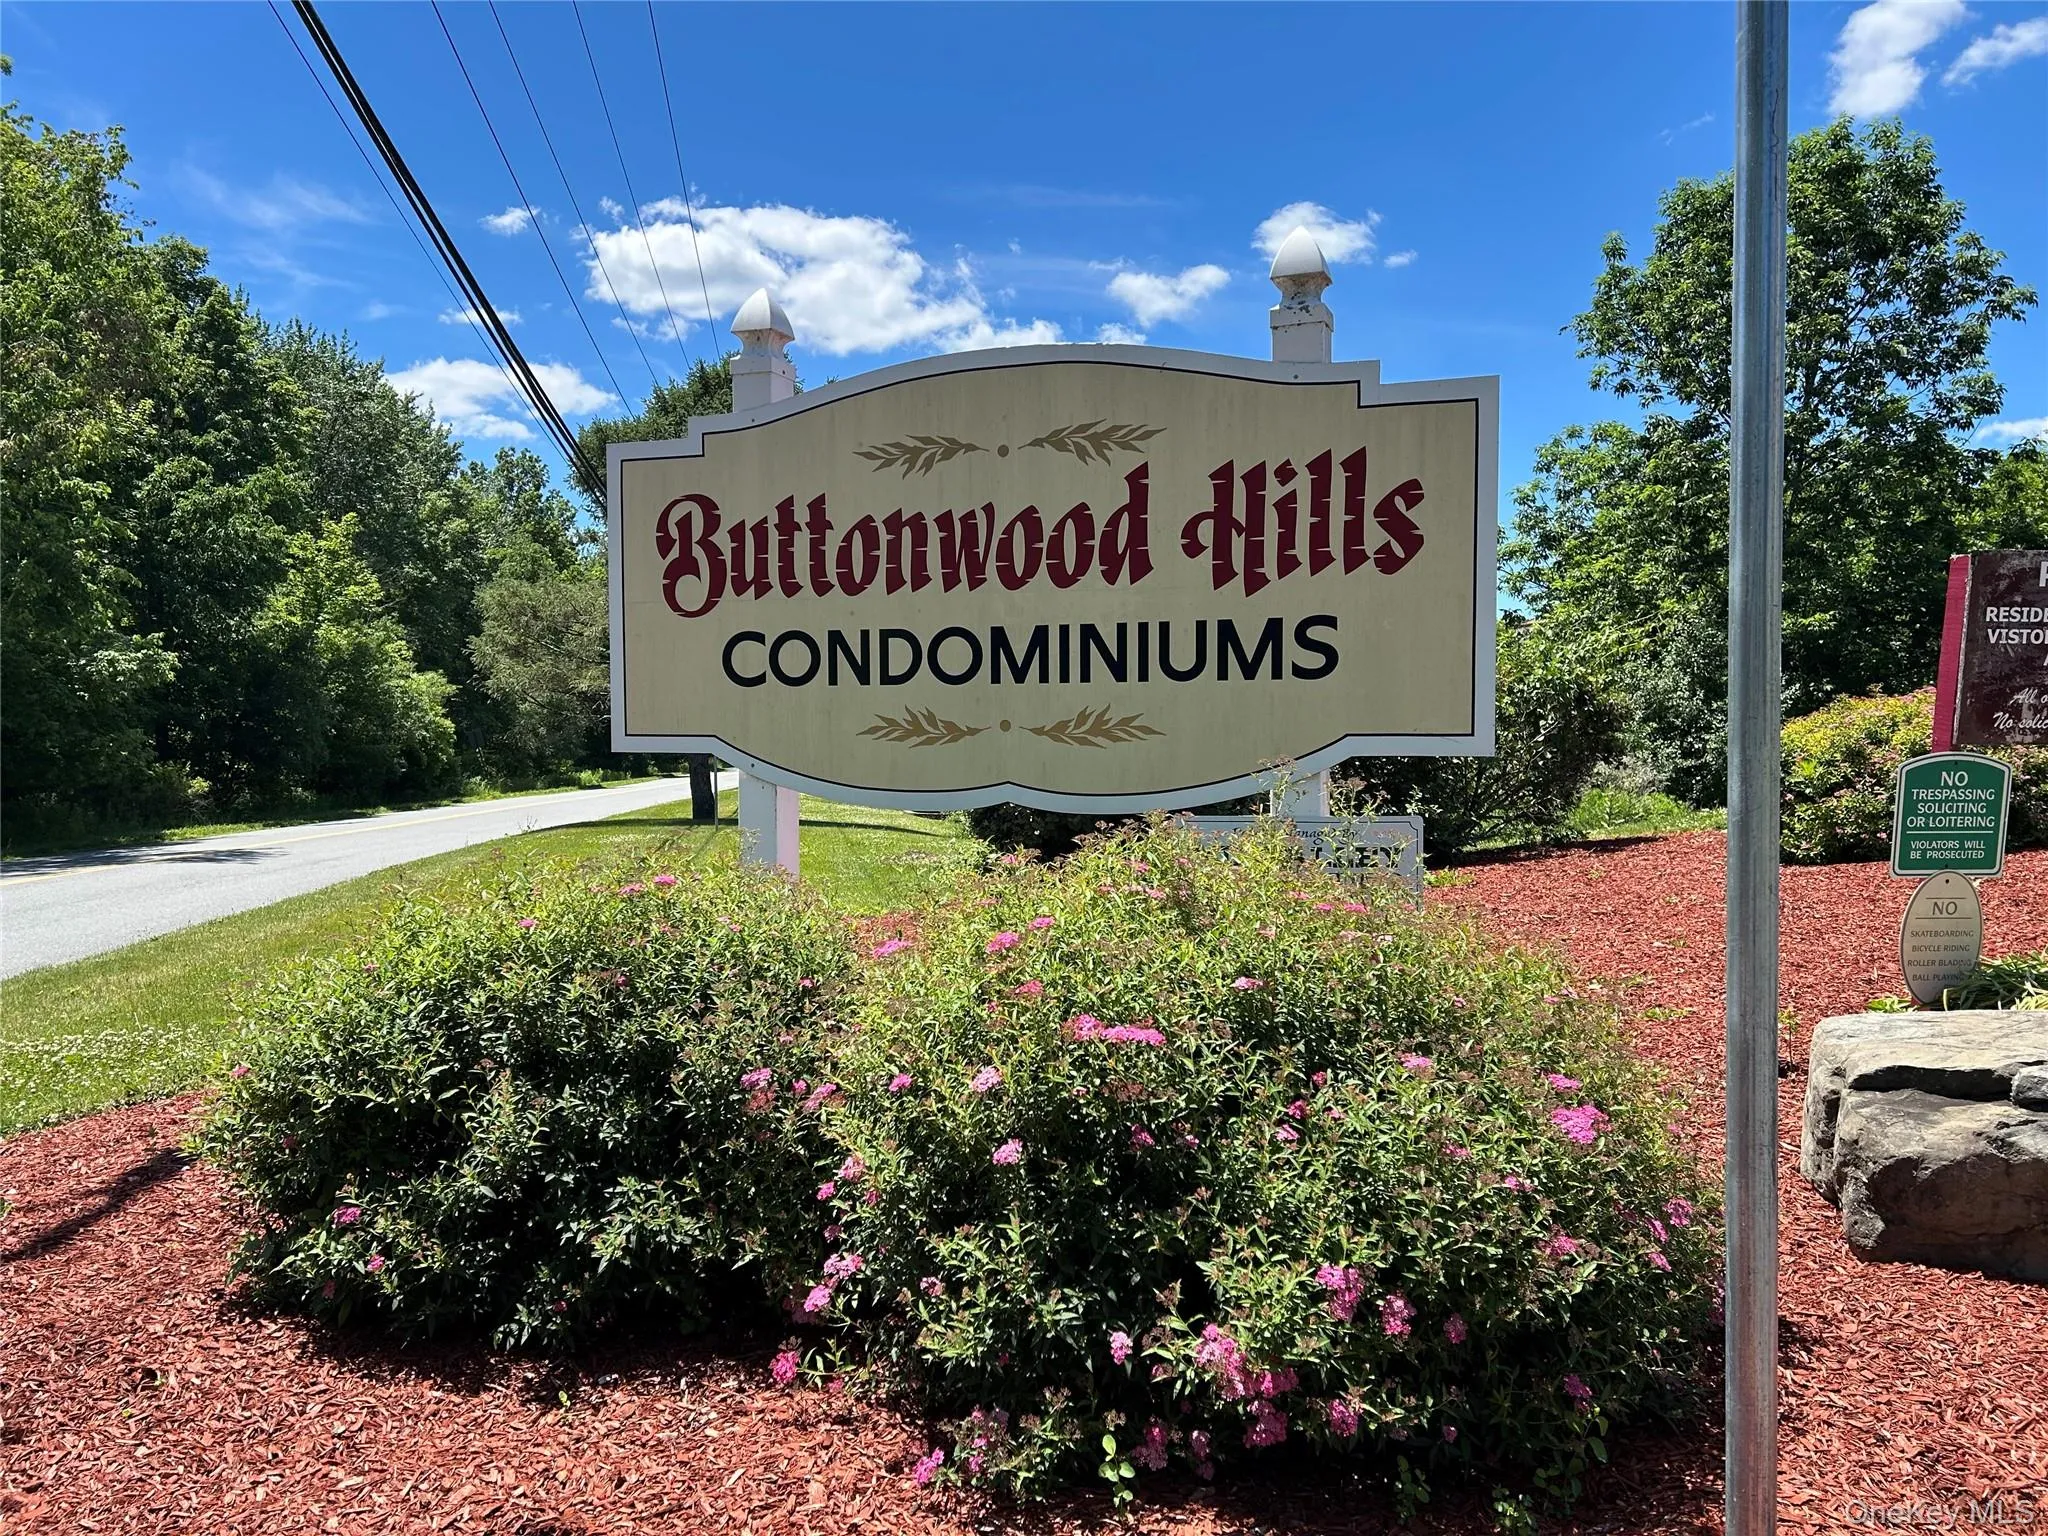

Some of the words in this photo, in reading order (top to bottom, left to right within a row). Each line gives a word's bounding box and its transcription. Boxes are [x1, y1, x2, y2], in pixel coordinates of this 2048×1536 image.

[656, 461, 1154, 618] Buttonwood
[1181, 446, 1426, 597] Hills
[721, 614, 1341, 688] CONDOMINIUMS
[2009, 687, 2038, 705] All
[1993, 712, 2013, 729] No
[1940, 771, 1969, 787] NO
[1911, 788, 1996, 800] TRESPASSING
[1917, 802, 1987, 814] SOLICITING
[1906, 816, 1925, 828] OR
[1929, 816, 1995, 828] LOITERING
[1910, 840, 1960, 849] VIOLATORS
[1964, 840, 1986, 849] WILL
[1910, 850, 1922, 859] BE
[1926, 850, 1985, 859] PROSECUTED
[1932, 900, 1958, 916] NO
[1910, 929, 1975, 938] SKATEBOARDING
[1911, 944, 1942, 953] BICYCLE
[1943, 944, 1971, 952] RIDING
[1907, 959, 1936, 967] ROLLER
[1912, 973, 1930, 982] BALL
